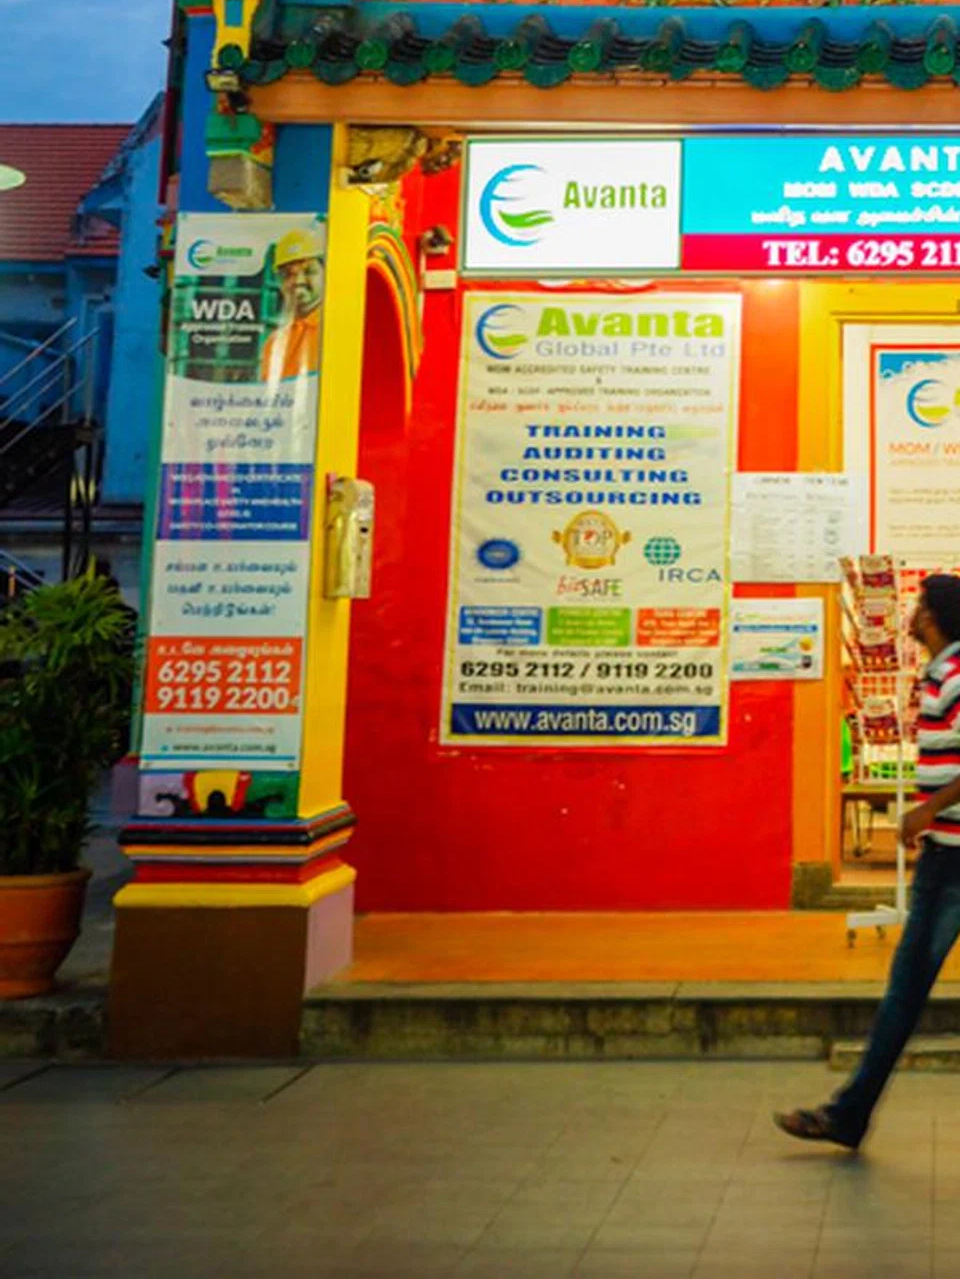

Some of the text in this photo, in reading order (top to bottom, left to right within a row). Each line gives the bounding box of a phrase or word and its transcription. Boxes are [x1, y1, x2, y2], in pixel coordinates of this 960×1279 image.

[564, 180, 668, 209] Avanta
[849, 181, 900, 199] WDA
[762, 239, 840, 266] TEL:
[847, 239, 915, 266] 6295
[192, 299, 255, 321] WDA
[536, 306, 725, 338] Avanta
[535, 340, 726, 359] Global Pte Ltd
[525, 424, 666, 439] TRAINING
[523, 447, 666, 461] AUDITING
[887, 442, 931, 456] MOM
[500, 468, 689, 483] CONSULTING
[485, 490, 702, 505] OUTSOURCING
[659, 568, 722, 582] IRCA
[158, 661, 291, 684] 6295 2112
[460, 661, 714, 679] 6295 2112 / 9119 2200
[458, 682, 714, 696] Email: training@avanta.com.sg
[156, 687, 289, 710] 9119 2200
[474, 708, 697, 735] www.avanta.com.sg
